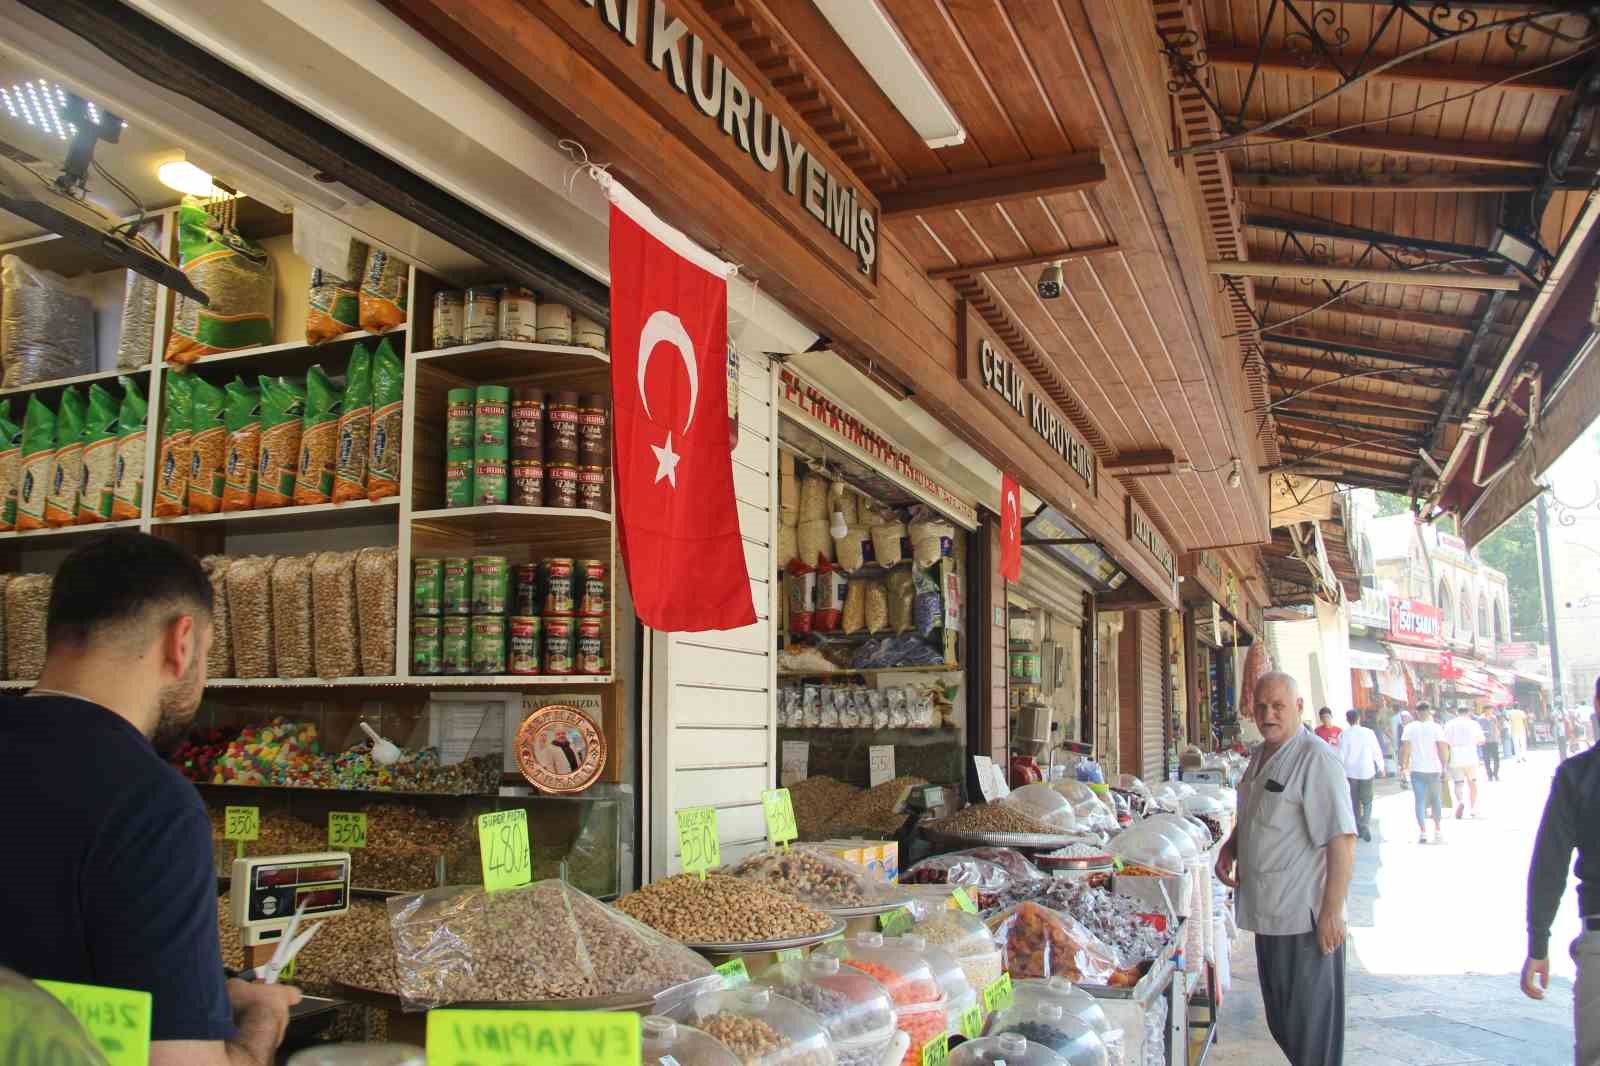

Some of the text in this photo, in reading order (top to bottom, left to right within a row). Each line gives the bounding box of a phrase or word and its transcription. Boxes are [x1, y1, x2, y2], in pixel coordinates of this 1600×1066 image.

[648, 3, 876, 274] KURUYEMİŞ
[981, 339, 1026, 417] ÇELİK
[1031, 391, 1093, 486] KURUYEMİŞ
